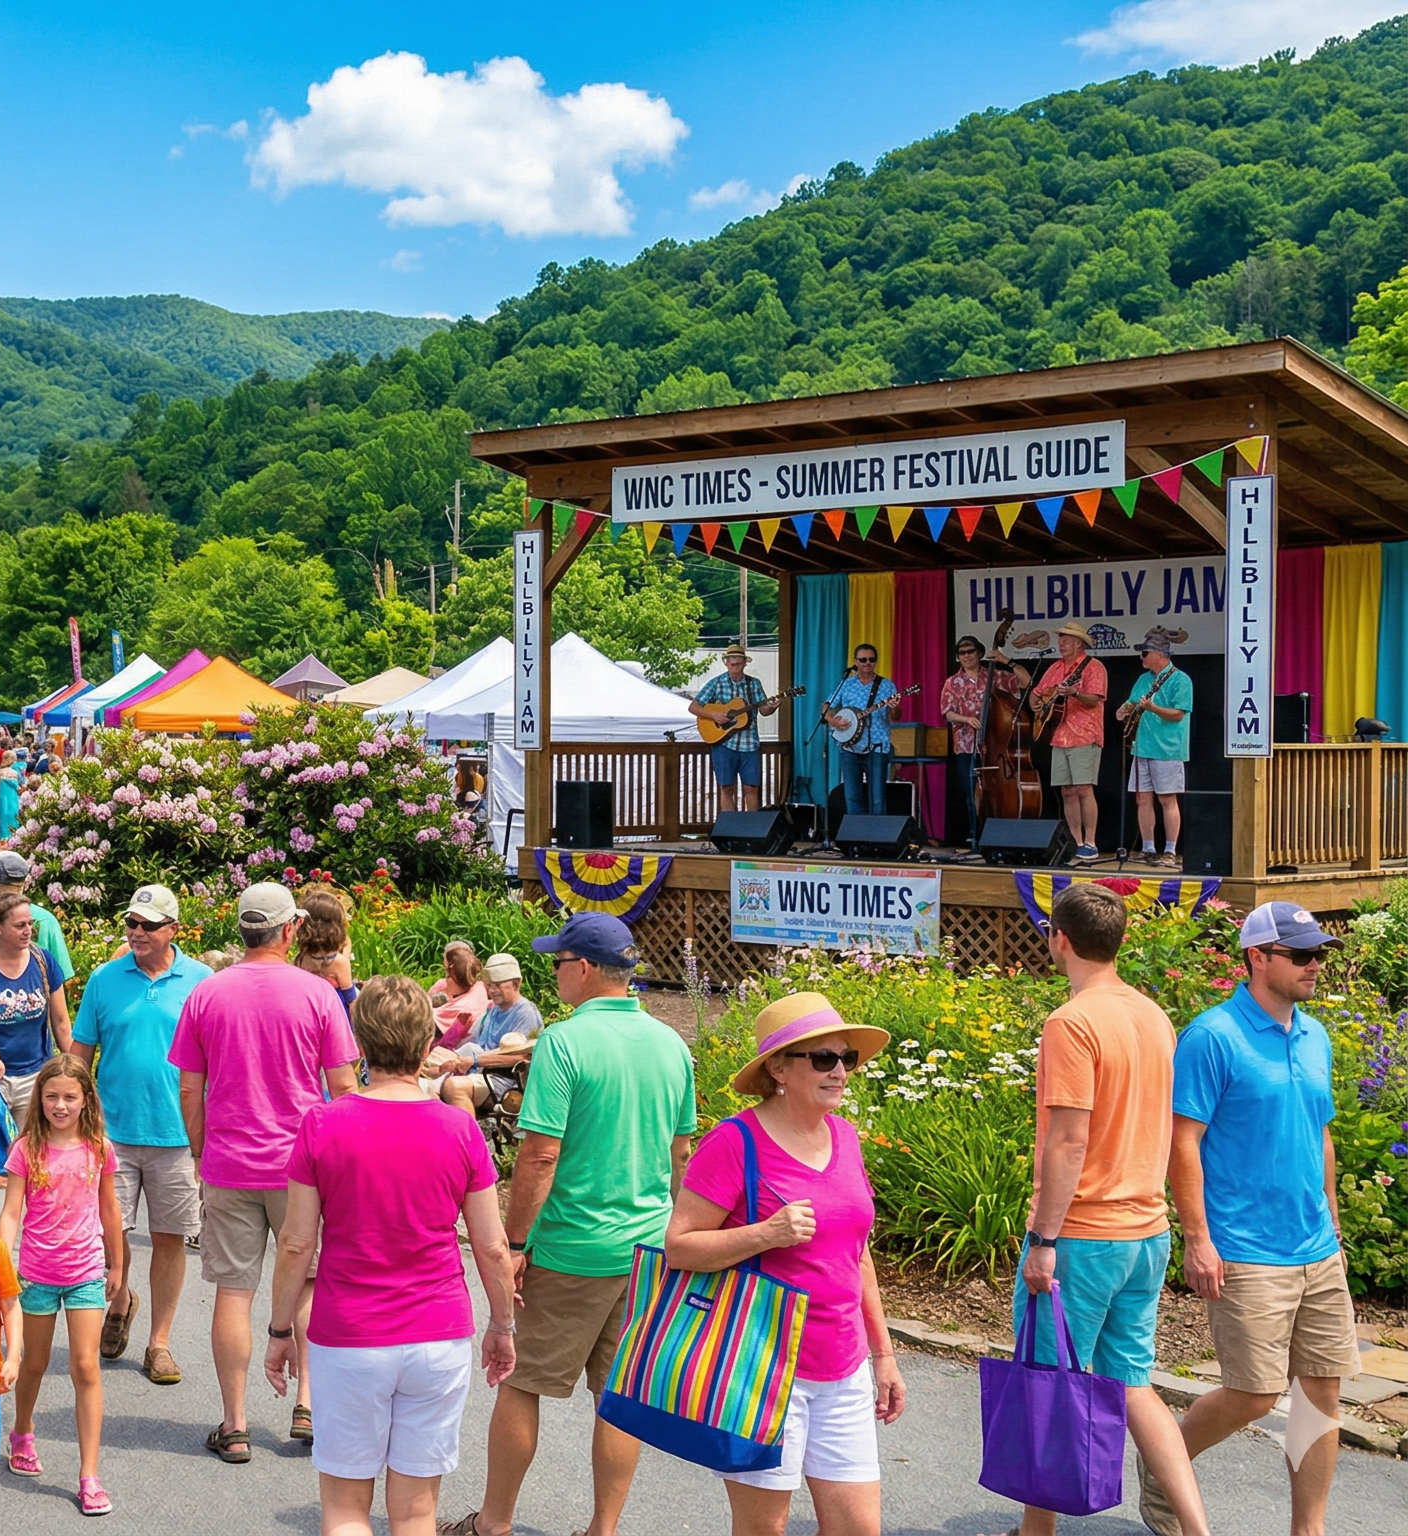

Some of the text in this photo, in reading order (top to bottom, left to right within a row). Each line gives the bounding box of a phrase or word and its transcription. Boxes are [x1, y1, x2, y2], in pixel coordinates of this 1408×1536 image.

[624, 475, 674, 510] WNC
[681, 468, 751, 506] TIMES
[776, 457, 884, 499] SUMMER
[893, 445, 1017, 490] FESTIVAL
[1026, 435, 1110, 479] GUIDE
[969, 566, 1226, 623] HILLBILLY JAM
[1239, 487, 1259, 664] HILLBILLY
[522, 540, 534, 678] HILLBILLY
[521, 689, 535, 733] JAM
[1237, 677, 1260, 735] JAM
[777, 880, 913, 920] WNC TIMES
